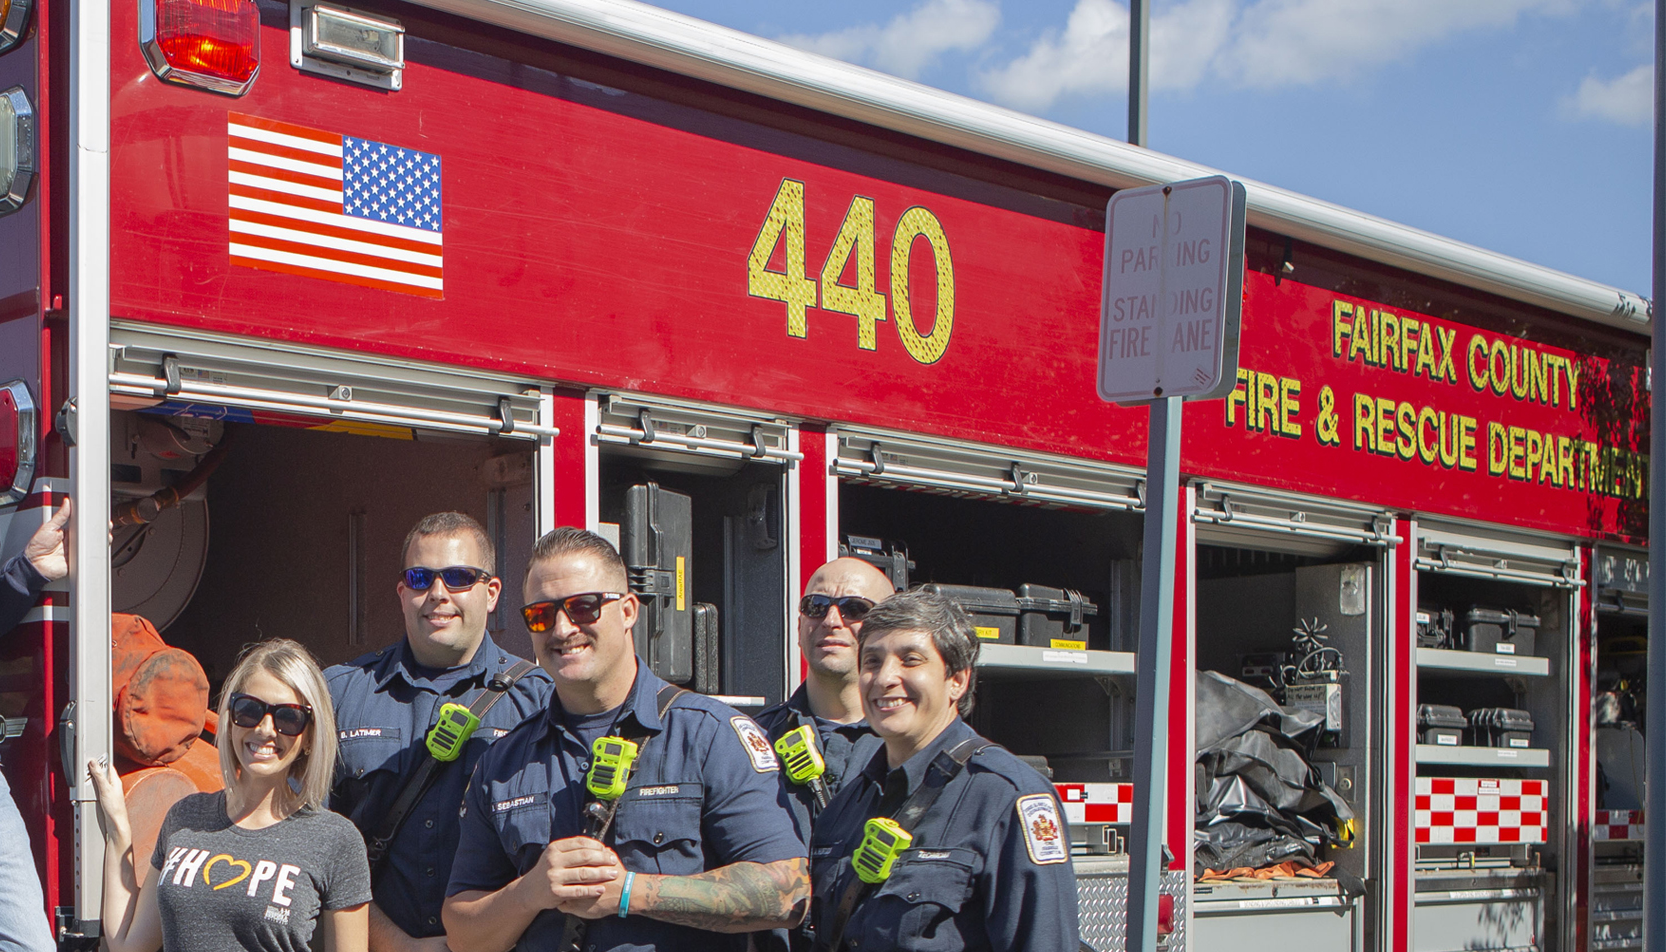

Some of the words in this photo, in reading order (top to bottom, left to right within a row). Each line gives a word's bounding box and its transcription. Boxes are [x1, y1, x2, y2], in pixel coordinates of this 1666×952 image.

[747, 176, 956, 365] 440
[1109, 325, 1152, 360] FIRE
[1332, 299, 1457, 385] FAIRFAX
[1468, 333, 1581, 411] COUNTY
[1225, 368, 1302, 438] FIRE
[1316, 384, 1341, 448] &
[1352, 392, 1477, 473] RESCUE
[350, 728, 382, 738] LATIMER
[497, 795, 535, 811] SEBASTIAN
[639, 786, 679, 796] FIREFIGHTER
